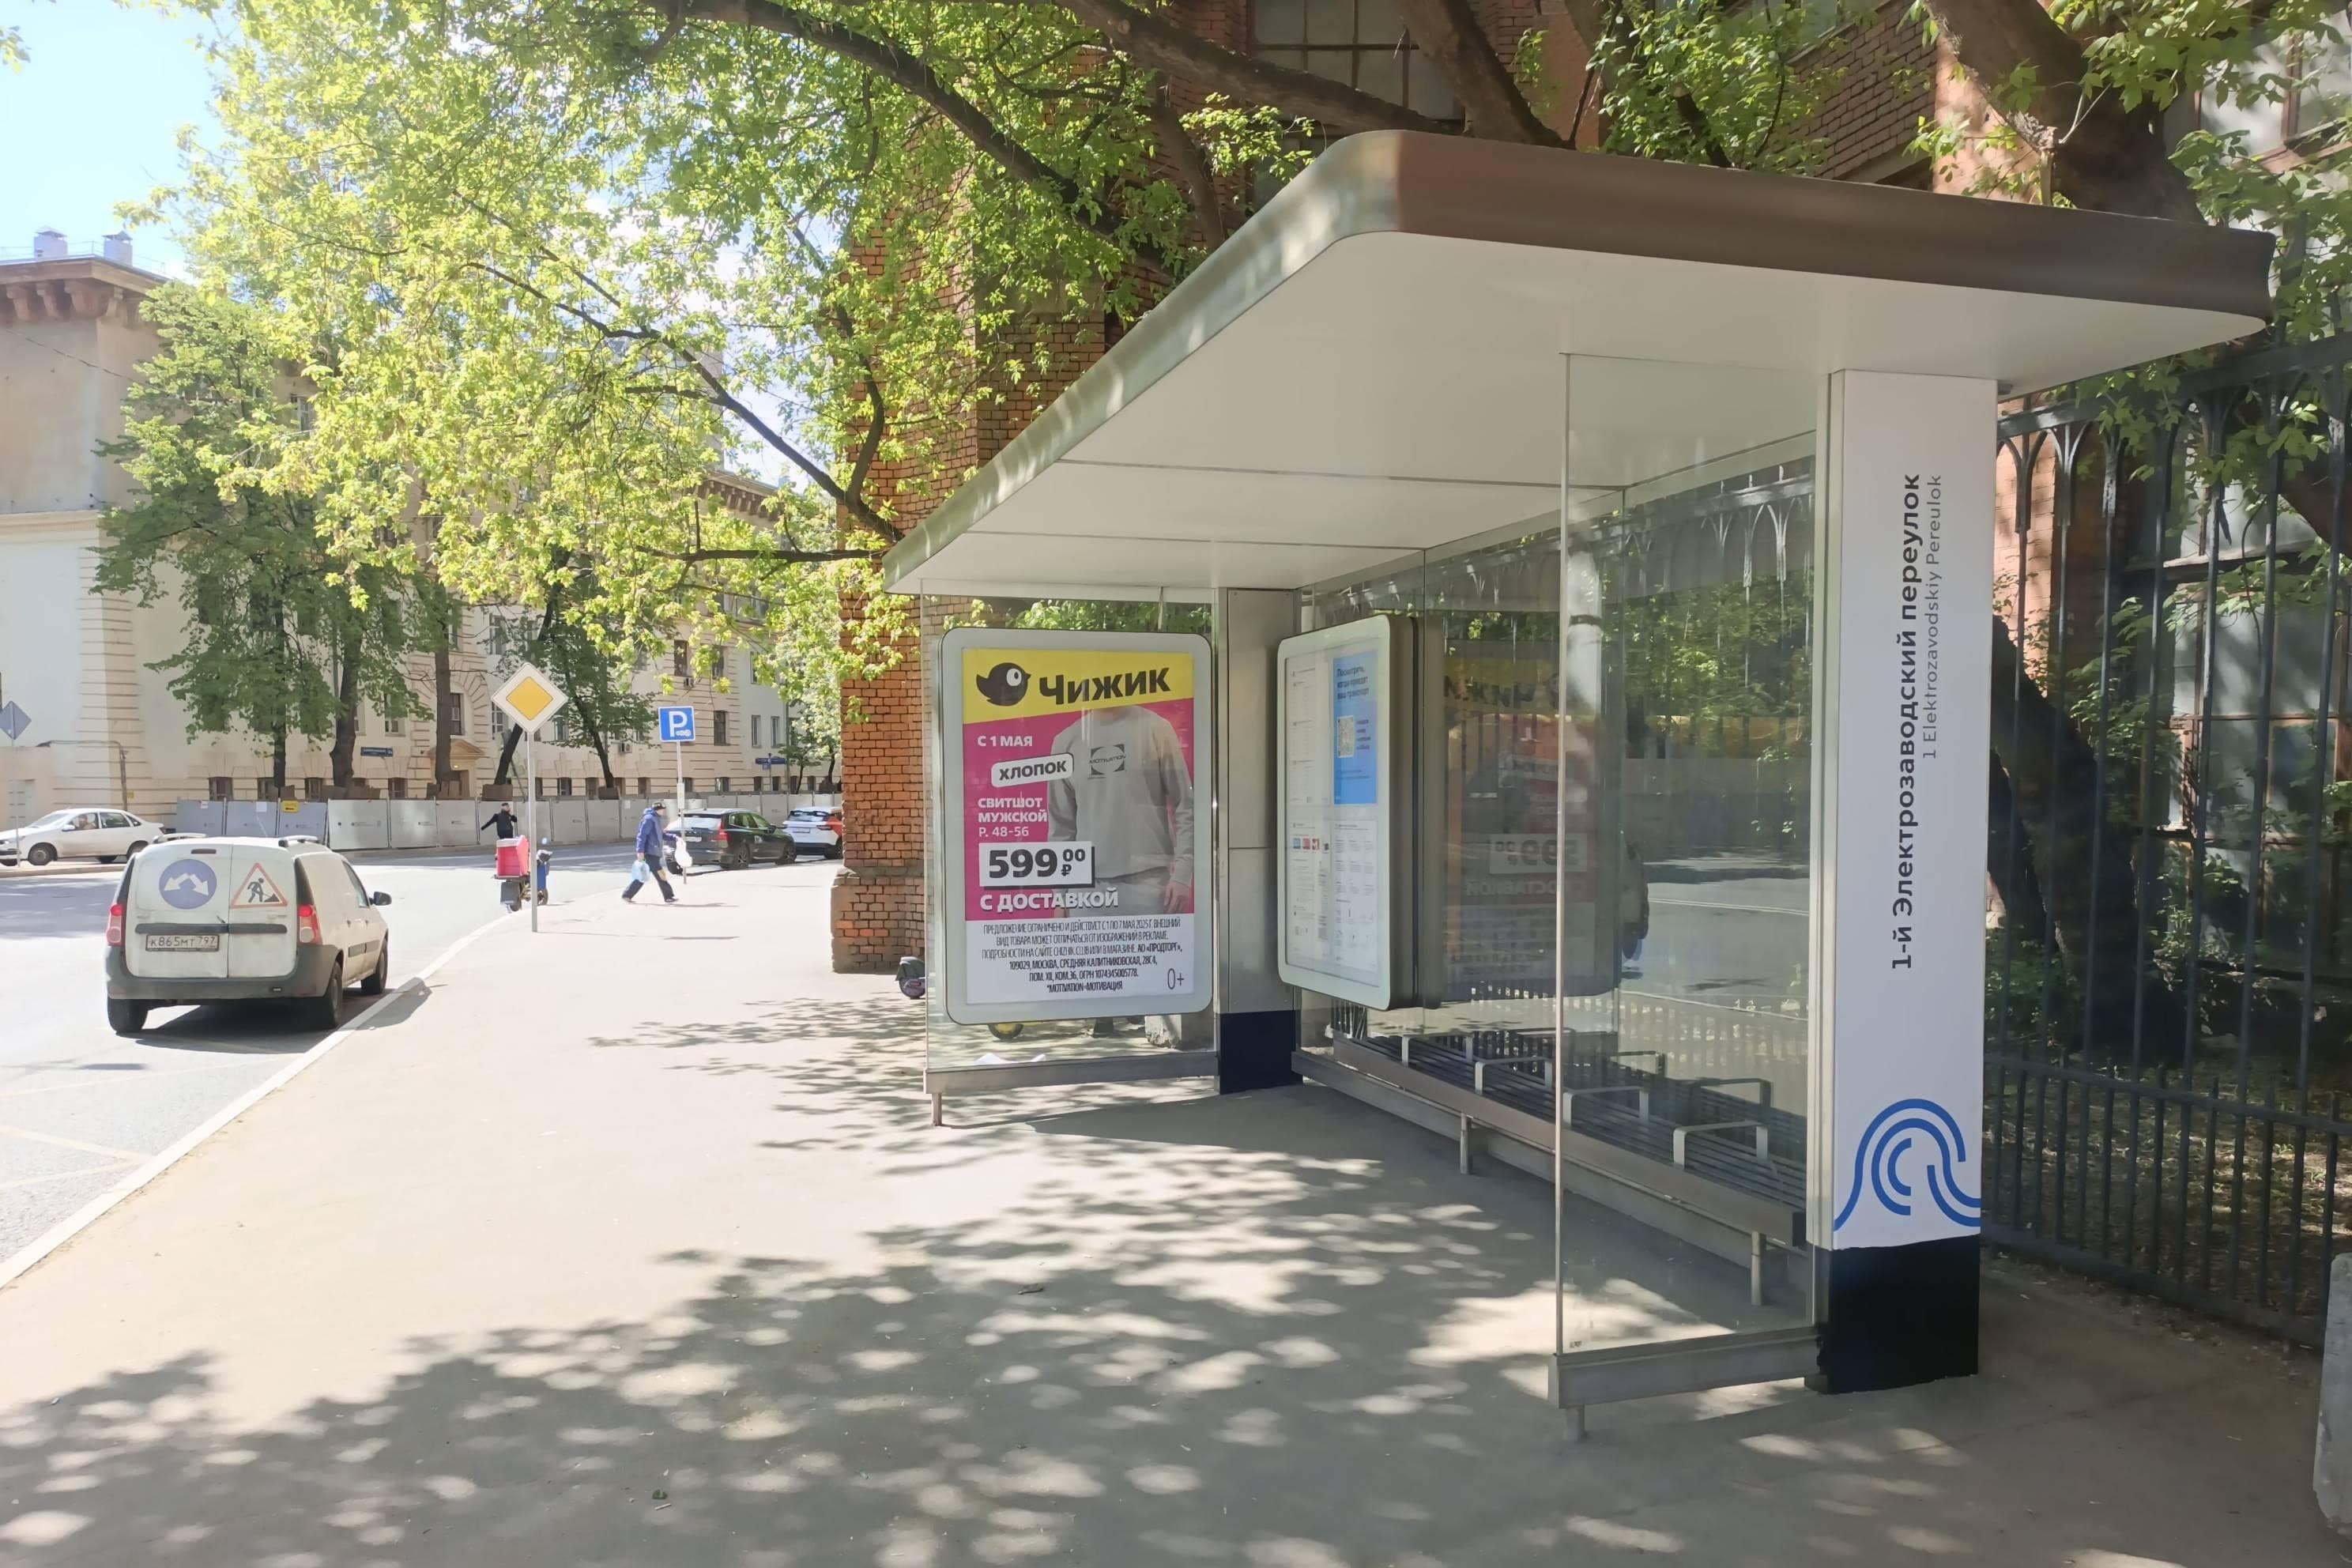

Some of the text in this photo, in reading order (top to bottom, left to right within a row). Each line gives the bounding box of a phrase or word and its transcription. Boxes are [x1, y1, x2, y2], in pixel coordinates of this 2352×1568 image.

[1923, 475, 1942, 759] 1 Elektrozavodskiy Pereulok
[669, 710, 688, 737] P
[1892, 474, 1924, 969] 1-й Электрозаводский переулок
[978, 736, 1033, 747] С 1 МАЯ
[999, 760, 1067, 781] ХЛОПОК
[978, 797, 1042, 808] СВИТШОТ
[978, 808, 1047, 823] МУЖСКОЙ
[978, 826, 1029, 838] Р. 48-56
[989, 849, 1057, 878] 599
[1063, 849, 1085, 861] 00
[980, 887, 1119, 913] С ДОСТАВКОЙ
[984, 923, 1026, 934] ПРЕДЛОЖЕНИЕ
[1027, 922, 1065, 933] ОГРАНИЧЕНО
[1065, 922, 1070, 931] И
[1070, 919, 1101, 933] ДЕЙСТВУЕТ
[1122, 919, 1136, 929] МАЯ
[1154, 917, 1181, 929] ВНЕШНИЙ
[997, 937, 1009, 947] ВИД
[1010, 936, 1031, 945] ТОВАРА
[1031, 935, 1052, 944] МОЖЕТ
[1054, 933, 1088, 944] ОТЛИЧАТЬСЯ
[982, 948, 1025, 960] ПОДРОБНОСТИ
[1027, 948, 1034, 957] НА
[1035, 945, 1053, 957] САЙТЕ
[1032, 959, 1059, 970] МОСКВА,
[1060, 958, 1086, 968] СРЕДНЯЯ
[1079, 970, 1094, 979] ОГРН
[1167, 968, 1185, 990] 0+
